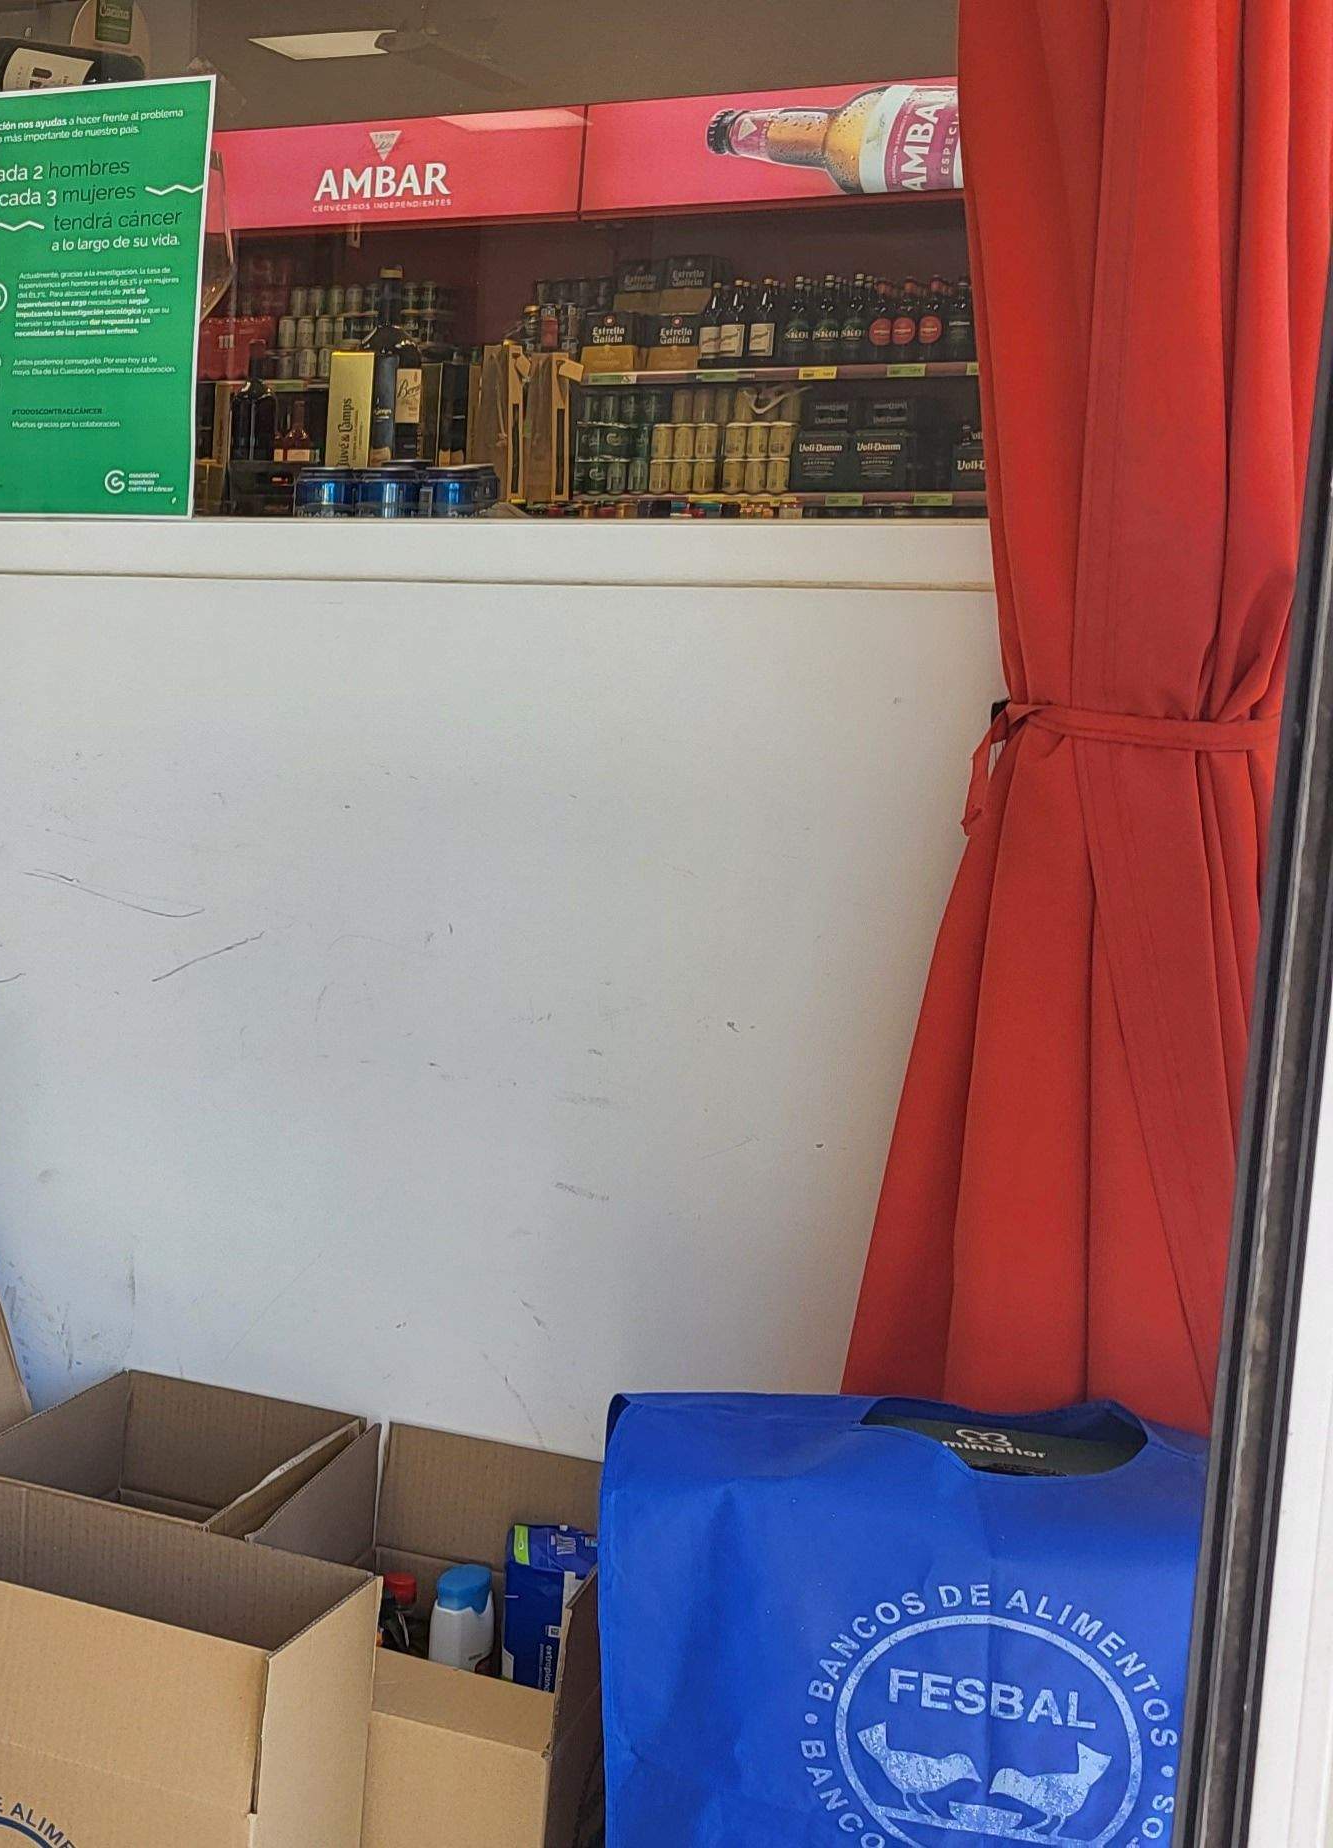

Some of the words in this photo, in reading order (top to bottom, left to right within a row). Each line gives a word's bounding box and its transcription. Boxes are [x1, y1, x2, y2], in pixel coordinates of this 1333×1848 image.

[18, 119, 34, 129] nos
[35, 114, 68, 129] ayudas
[76, 114, 101, 125] hacer
[102, 112, 129, 123] frente
[141, 108, 184, 121] problema
[24, 130, 70, 142] importante
[72, 128, 84, 138] de
[85, 126, 119, 137] nuestro
[33, 165, 44, 180] 2
[48, 159, 130, 179] hombres
[313, 162, 452, 202] AMBAR
[47, 190, 57, 206] 3
[62, 184, 136, 205] mujeres
[312, 201, 371, 213] CERVECEROS
[373, 198, 452, 210] INDEPENDIENTES
[53, 210, 112, 232] tendrá
[118, 208, 182, 228] cáncer
[51, 242, 59, 251] a
[62, 238, 74, 250] lo
[77, 237, 110, 254] largo
[114, 235, 130, 248] de
[133, 236, 148, 248] su
[152, 233, 180, 247] vida.
[591, 326, 625, 337] Estrella
[592, 334, 623, 344] Galicia
[659, 327, 693, 338] Estrella
[660, 335, 691, 345] Galicia
[799, 442, 843, 453] Voll-Damm
[857, 441, 902, 452] Voll-Damm
[941, 1439, 1047, 1459] mimaflor
[807, 1590, 928, 1703] BANCOS
[937, 1583, 991, 1609] DE
[1004, 1588, 1180, 1749] ALIMENTOS
[887, 1668, 1097, 1731] FESBAL
